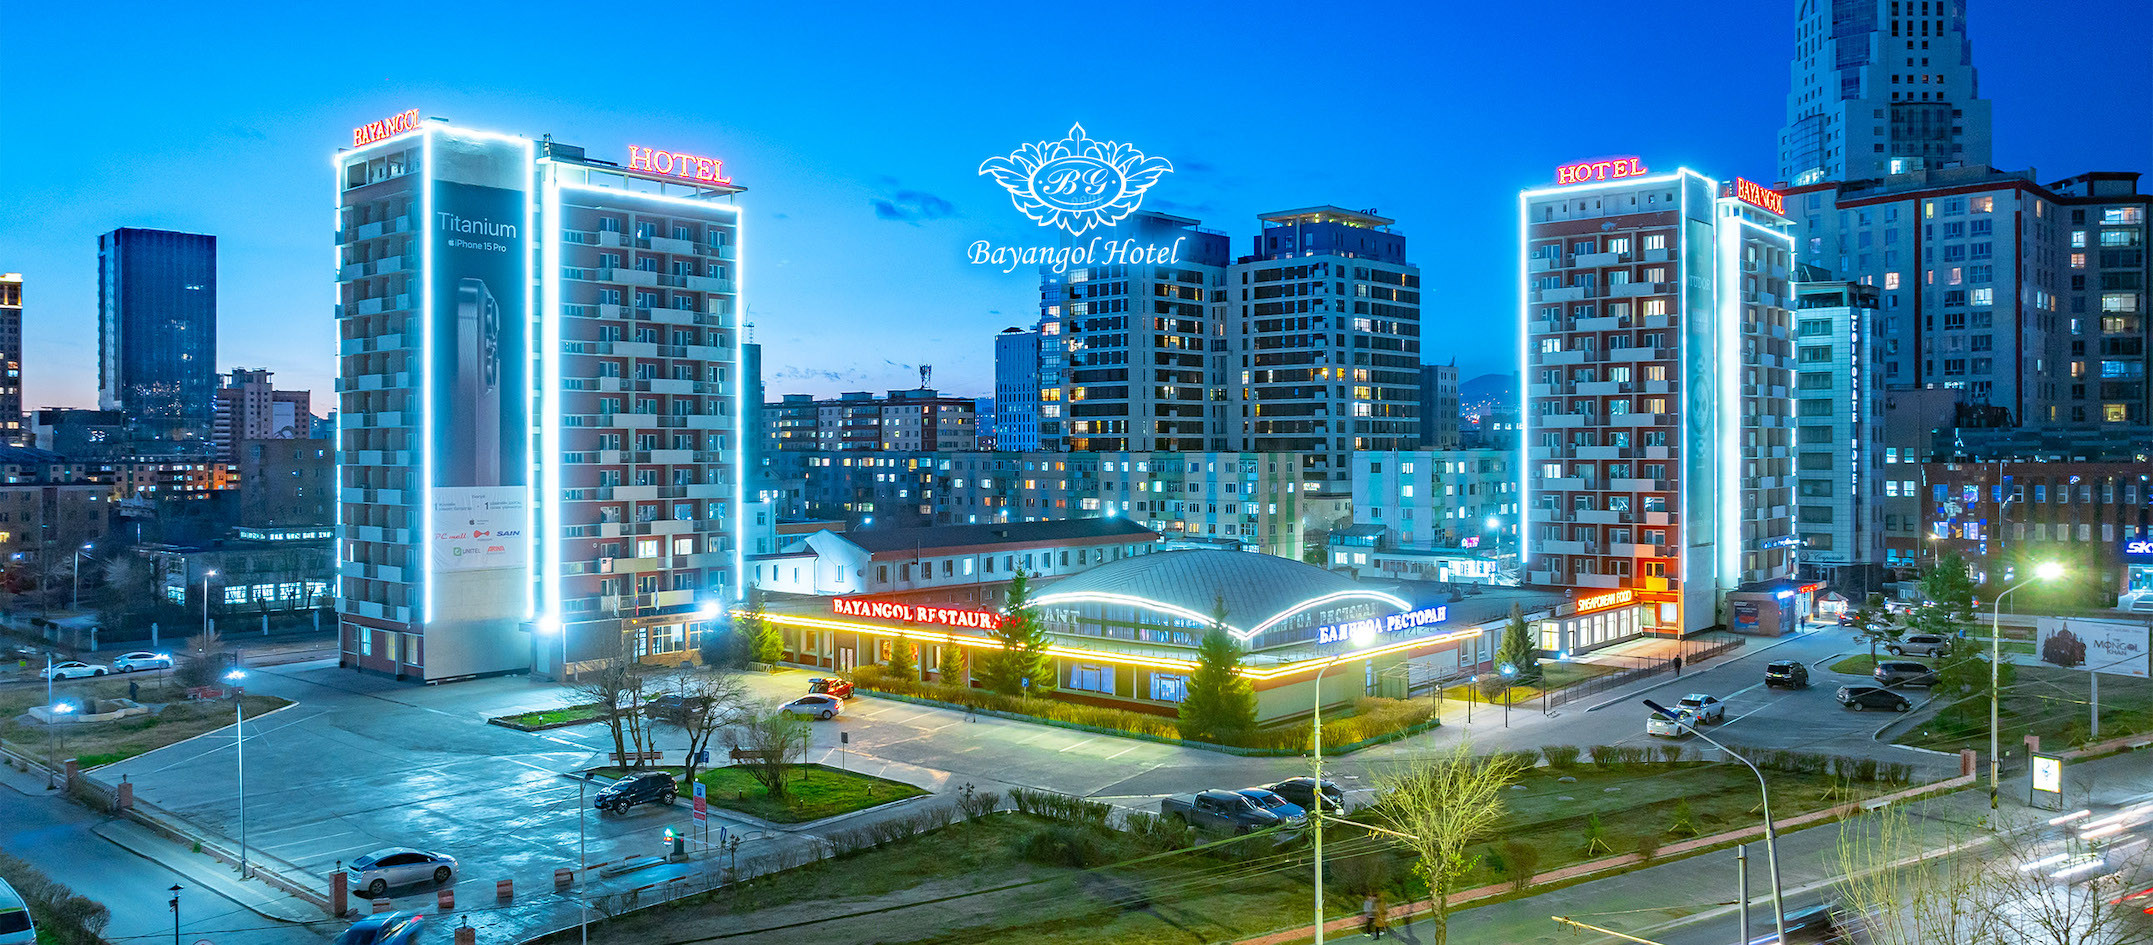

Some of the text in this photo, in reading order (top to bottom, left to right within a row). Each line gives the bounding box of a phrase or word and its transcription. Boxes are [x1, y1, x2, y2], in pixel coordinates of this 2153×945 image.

[353, 108, 422, 147] BAYANGOL
[629, 145, 731, 183] HOTEL
[1557, 158, 1647, 185] HOTEL
[1737, 177, 1785, 214] BAYANGOL
[437, 211, 517, 239] Titanium
[454, 239, 507, 253] iPhone 15 Pro
[833, 598, 913, 622] BAYANGOL
[1616, 589, 1633, 604] FOOD
[1386, 606, 1447, 633] РЕСТОРАН
[2093, 639, 2141, 653] MONGOL
